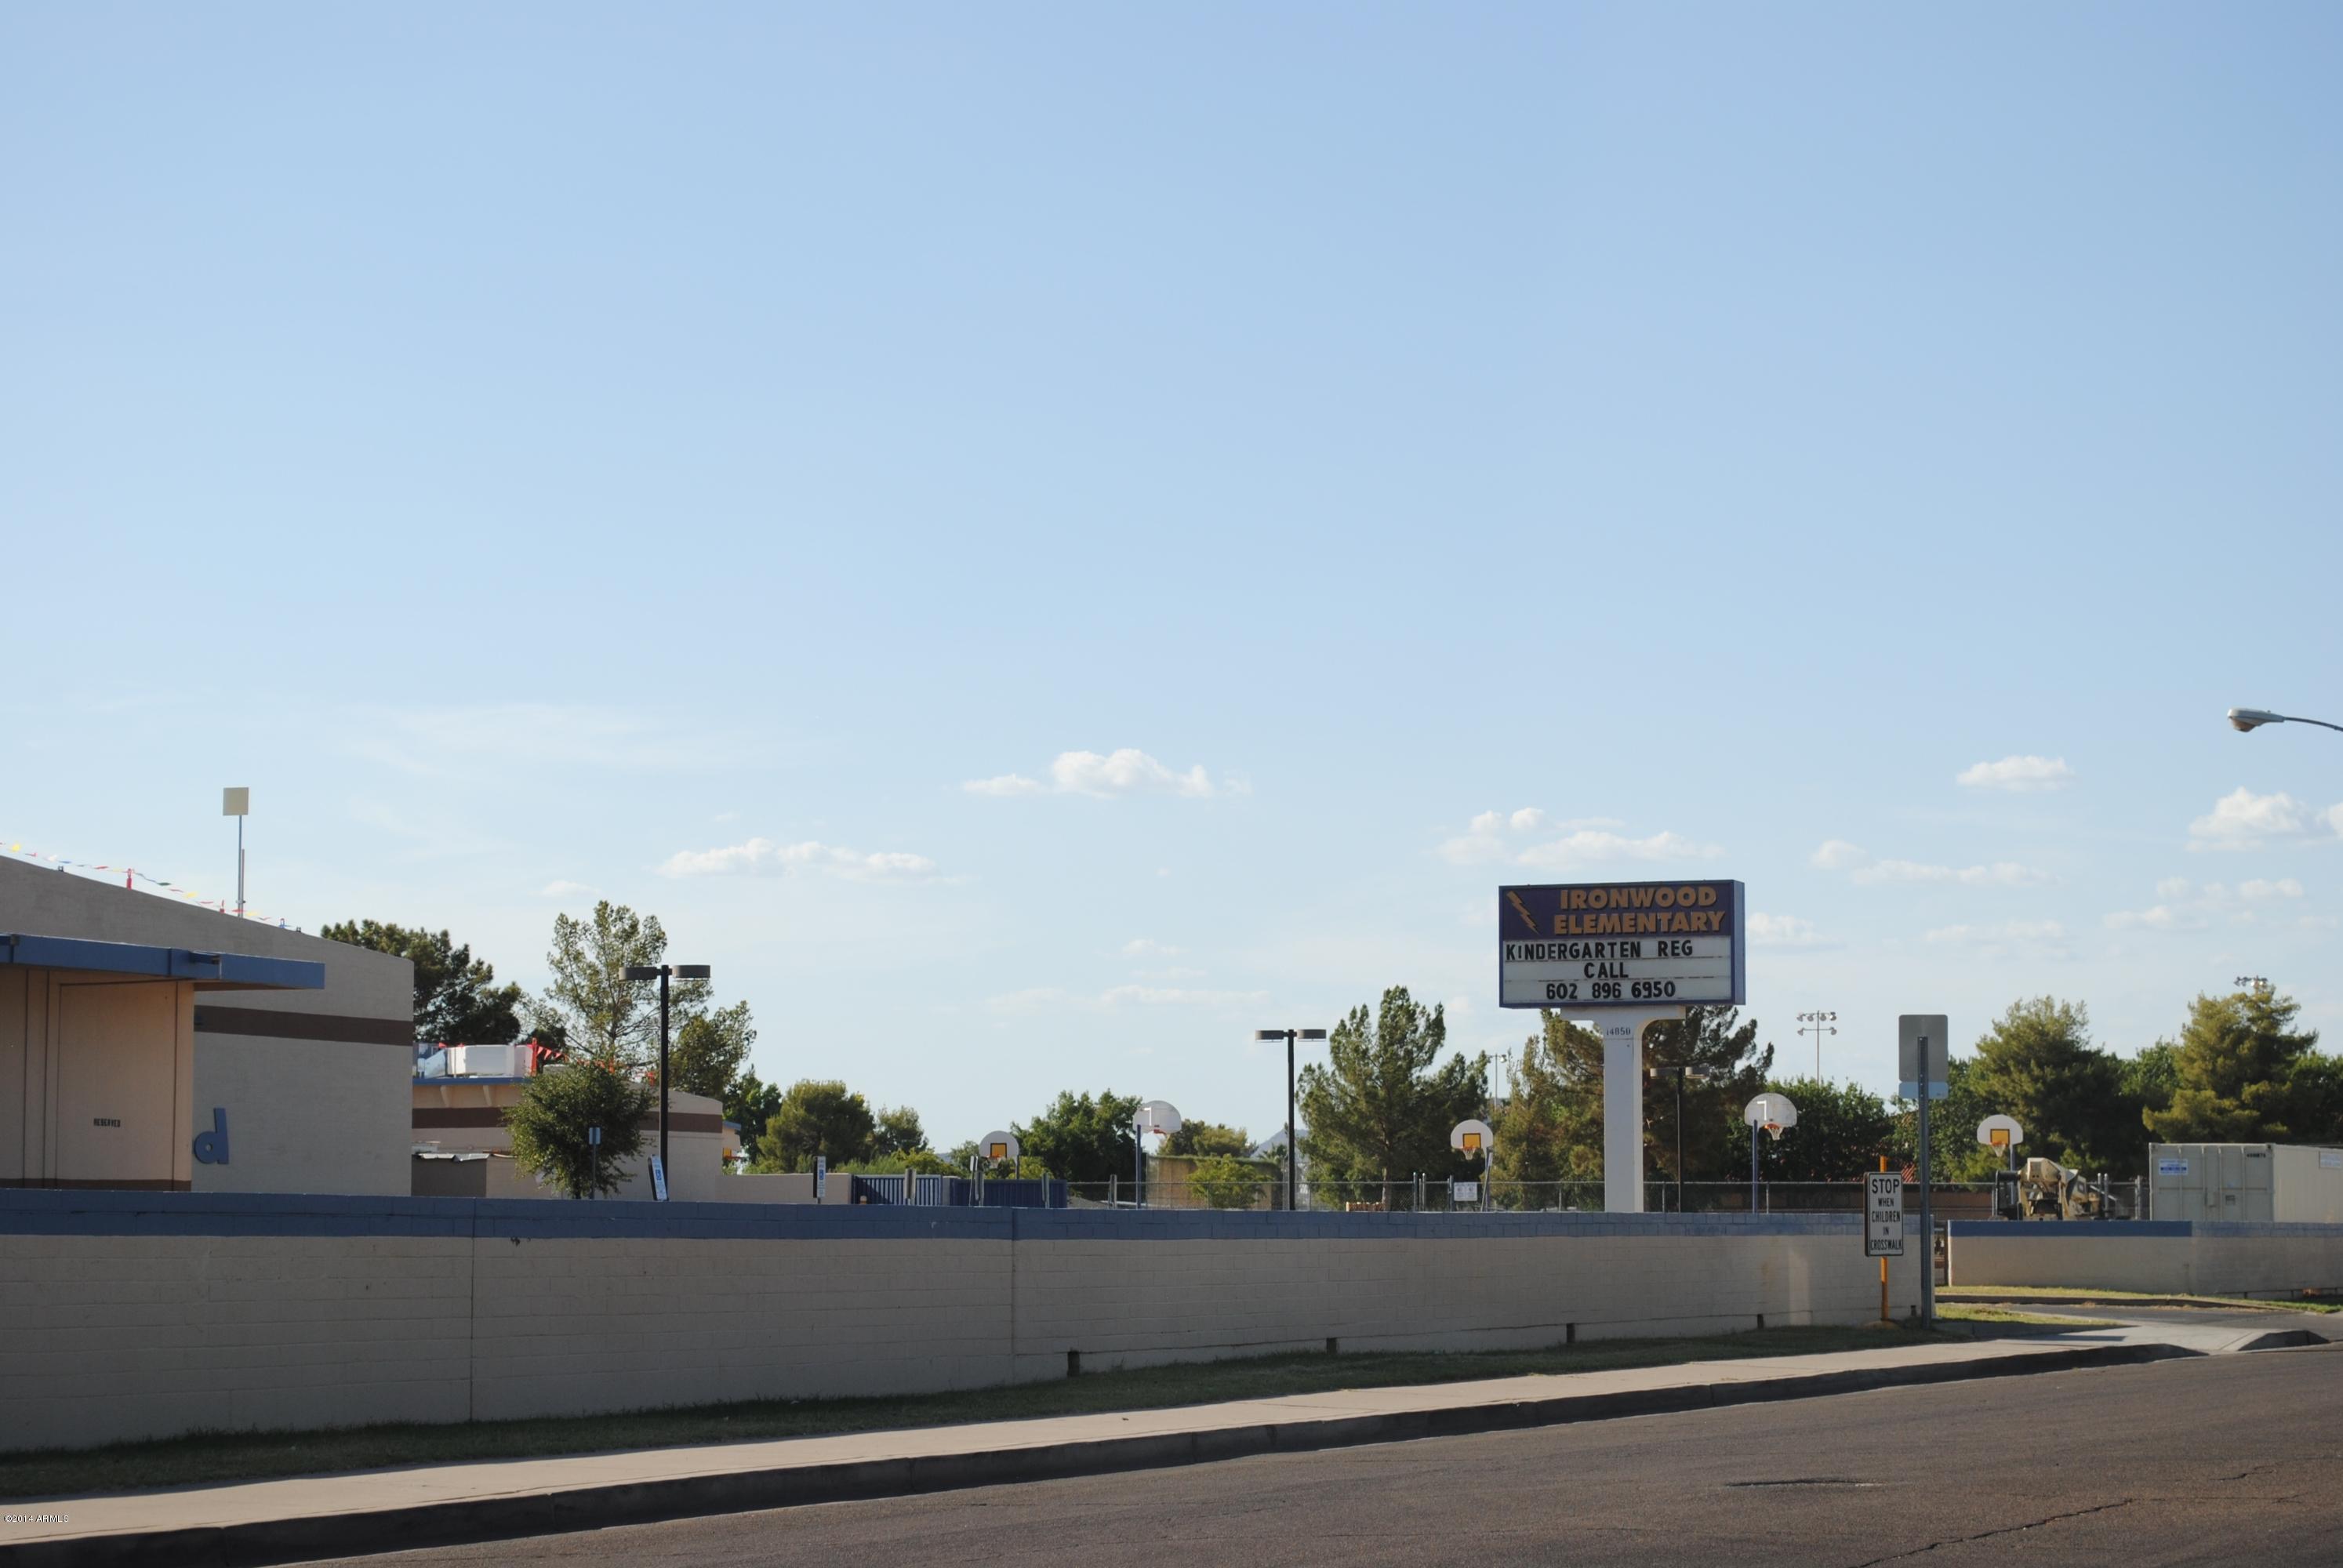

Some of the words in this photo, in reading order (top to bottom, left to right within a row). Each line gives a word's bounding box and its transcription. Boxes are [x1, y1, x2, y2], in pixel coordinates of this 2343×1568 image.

[1560, 887, 1716, 909] IRONWOOD
[1554, 911, 1725, 935] ELEMENTARY
[1506, 942, 1641, 960] KINDERGARTEN
[1658, 939, 1693, 956] REG
[1583, 962, 1629, 979] CALL
[1546, 982, 1578, 1000] 602
[1591, 982, 1622, 1000] 896
[1631, 980, 1676, 999] 6950
[93, 1118, 120, 1127] RESERVED
[1872, 1179, 1899, 1193] STOP
[1878, 1198, 1894, 1207] WHEN
[1872, 1211, 1900, 1222] CHILDREN
[1883, 1227, 1889, 1236] IN
[1869, 1239, 1902, 1250] CROSSWALK
